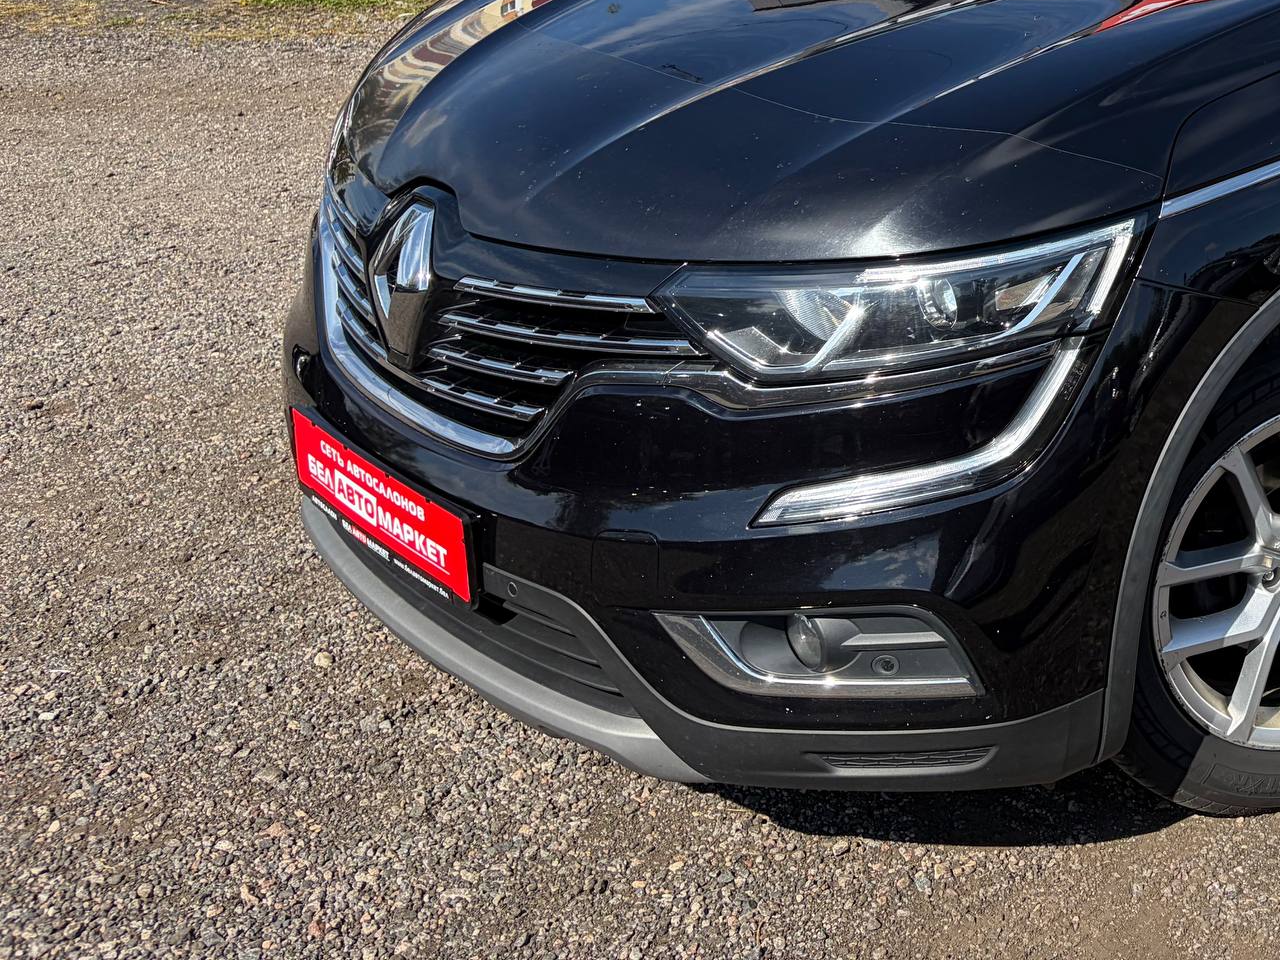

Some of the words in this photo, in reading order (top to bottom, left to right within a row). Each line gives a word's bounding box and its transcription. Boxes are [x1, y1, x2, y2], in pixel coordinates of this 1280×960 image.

[308, 453, 335, 491] БЕЛ
[338, 477, 375, 520] АВТО
[377, 506, 448, 567] МАРКЕТ
[320, 440, 344, 467] СЕТЬ
[347, 459, 425, 521] АВТОСАЛОНОВ
